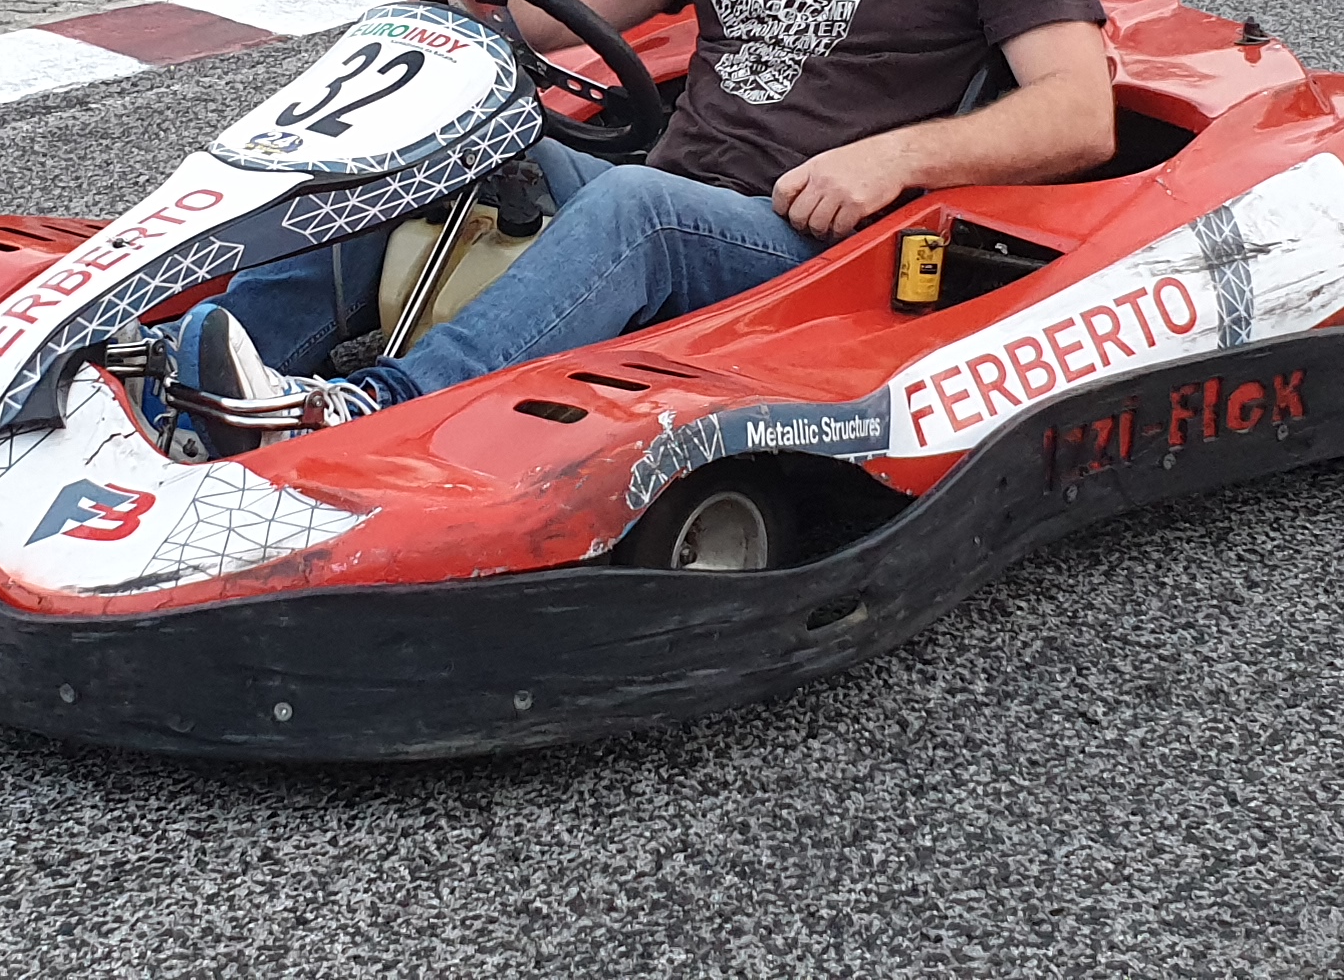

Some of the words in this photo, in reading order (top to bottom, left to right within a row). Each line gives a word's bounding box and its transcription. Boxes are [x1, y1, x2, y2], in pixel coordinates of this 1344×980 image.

[349, 22, 471, 54] EUROINDY
[275, 41, 426, 138] 32
[904, 276, 1198, 448] FERBERTO
[746, 418, 819, 448] Metallic
[820, 414, 881, 443] Structures
